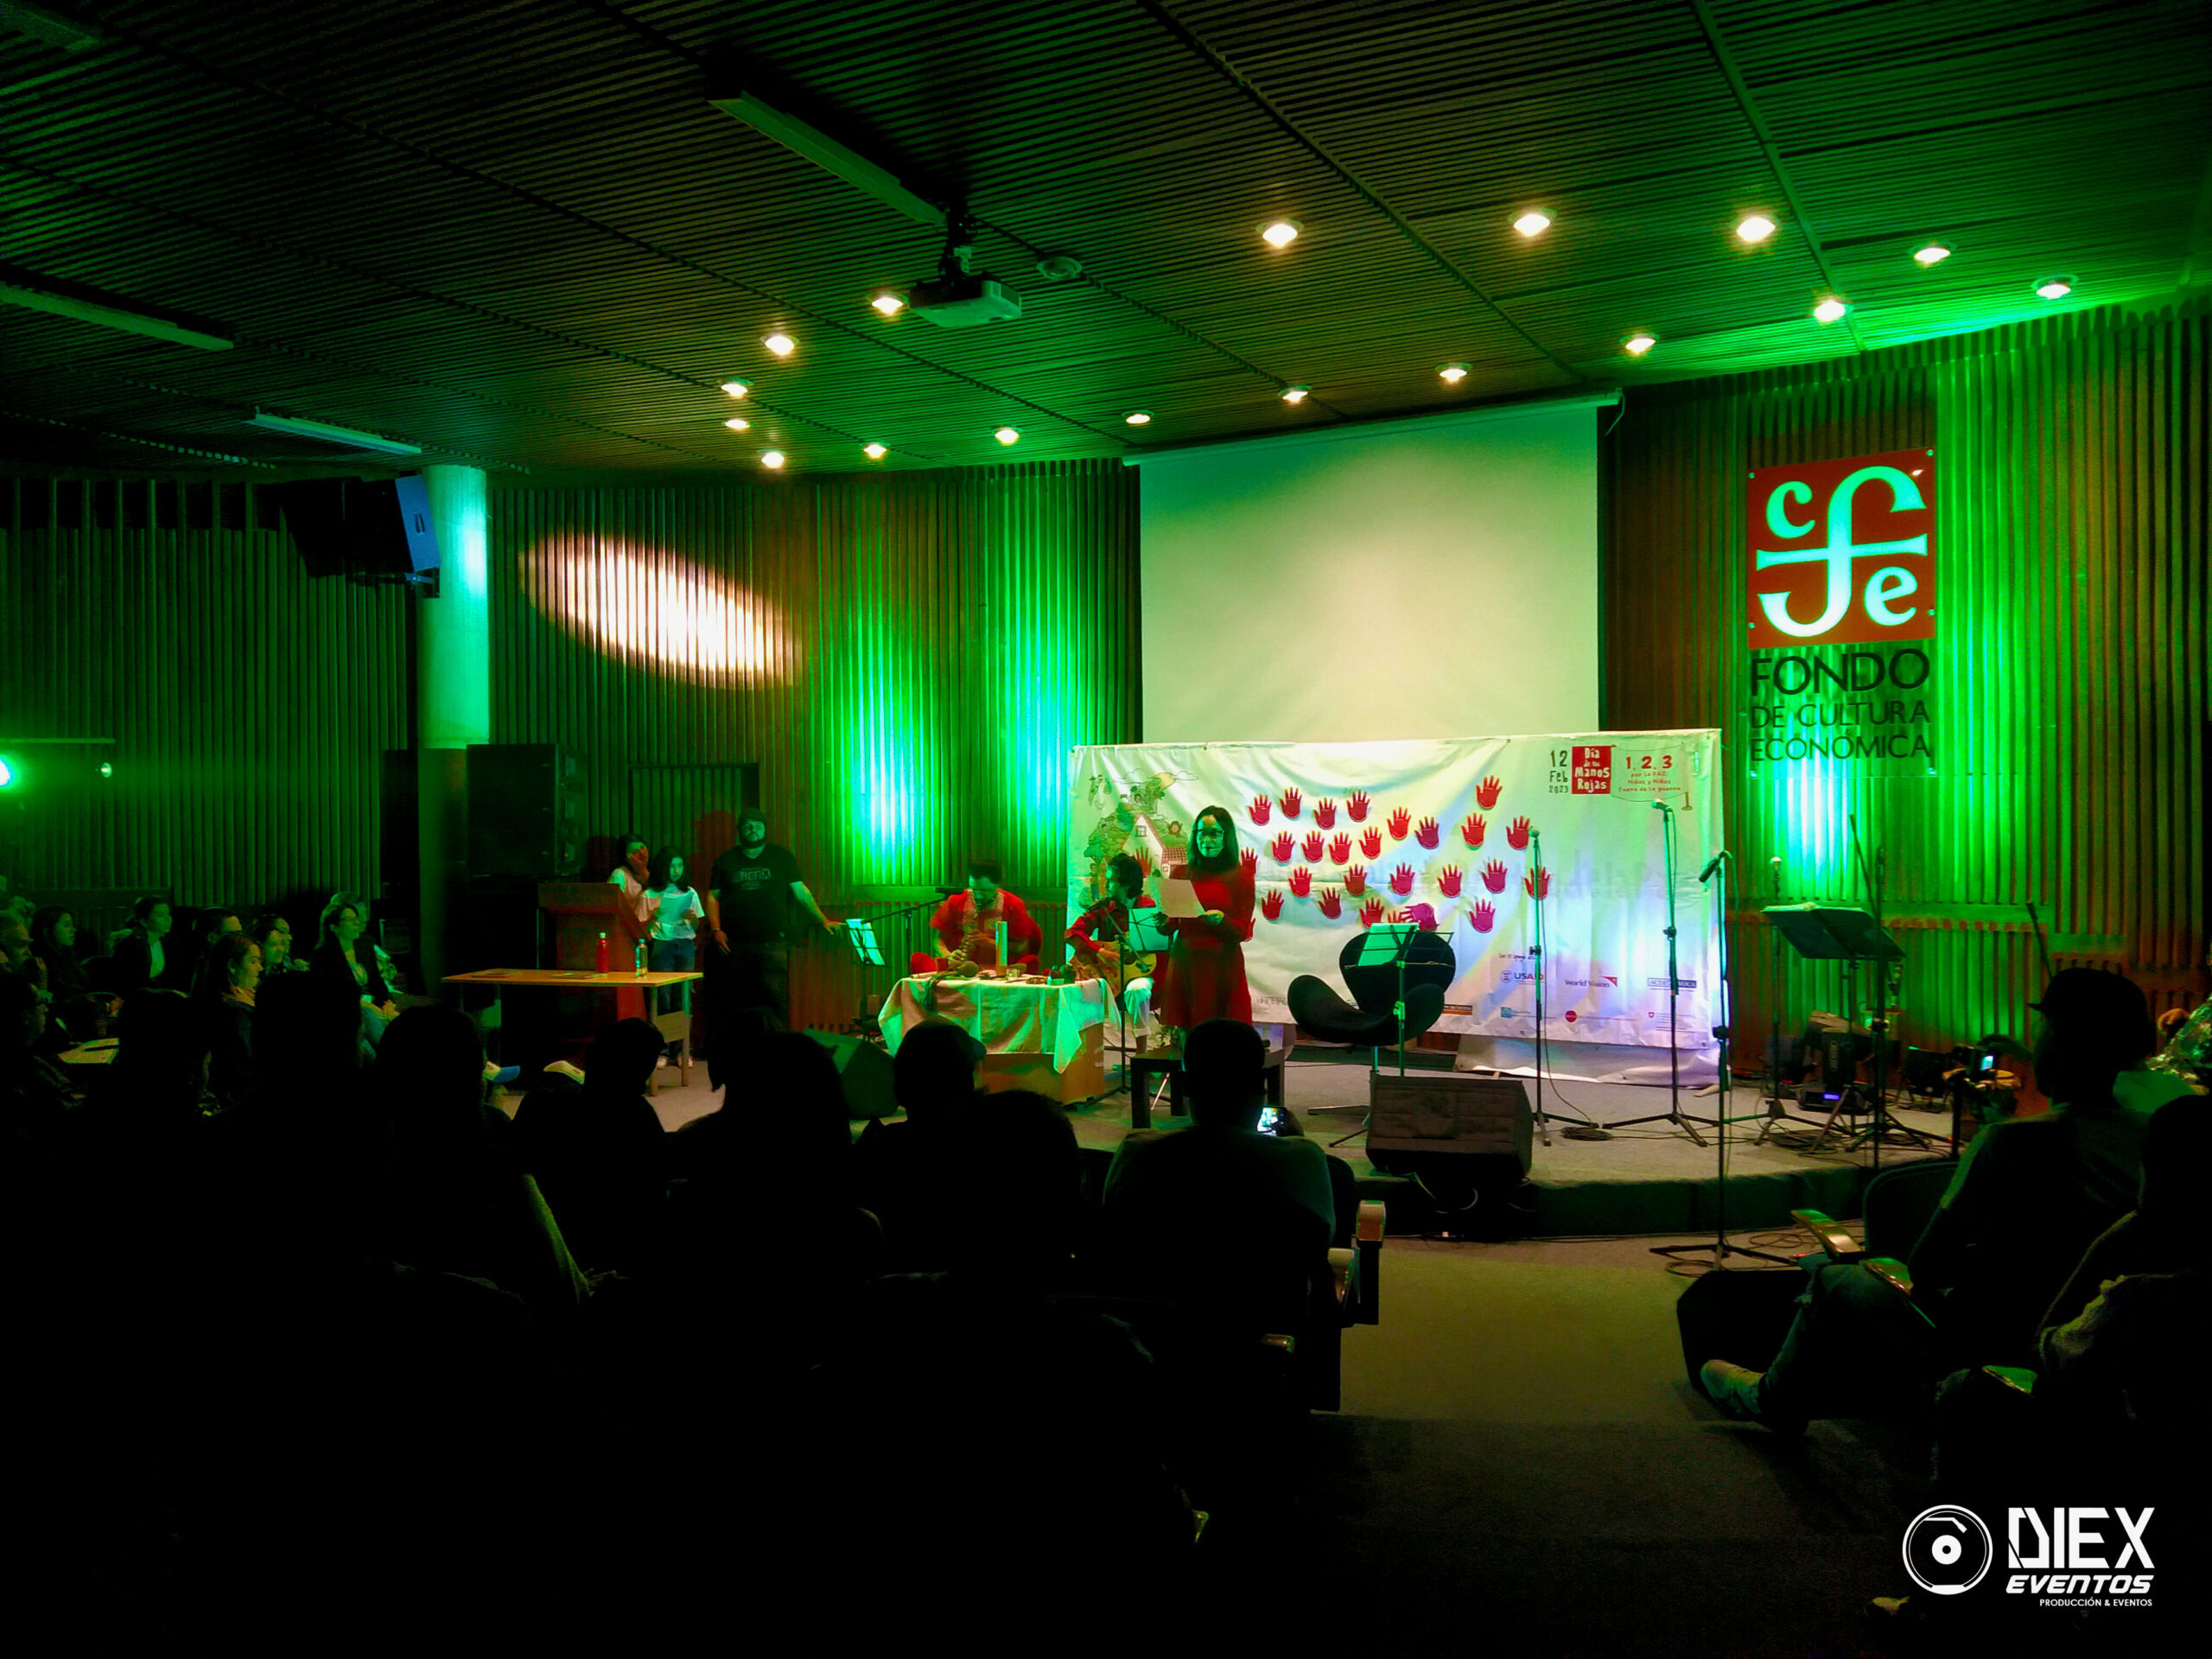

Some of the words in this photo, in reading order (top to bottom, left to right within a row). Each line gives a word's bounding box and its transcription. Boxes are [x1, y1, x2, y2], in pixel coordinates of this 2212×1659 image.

[1751, 648, 1930, 696] FONDO
[1751, 704, 1786, 729] DE
[1798, 700, 1930, 727] CULTURA
[1751, 729, 1930, 761] ECONÓMICA
[1550, 749, 1567, 767] 12
[1584, 747, 1600, 759] Día
[1662, 754, 1672, 769] 3
[1550, 770, 1568, 782] Feb
[1548, 785, 1568, 793] 2023
[1578, 778, 1607, 793] Rojas
